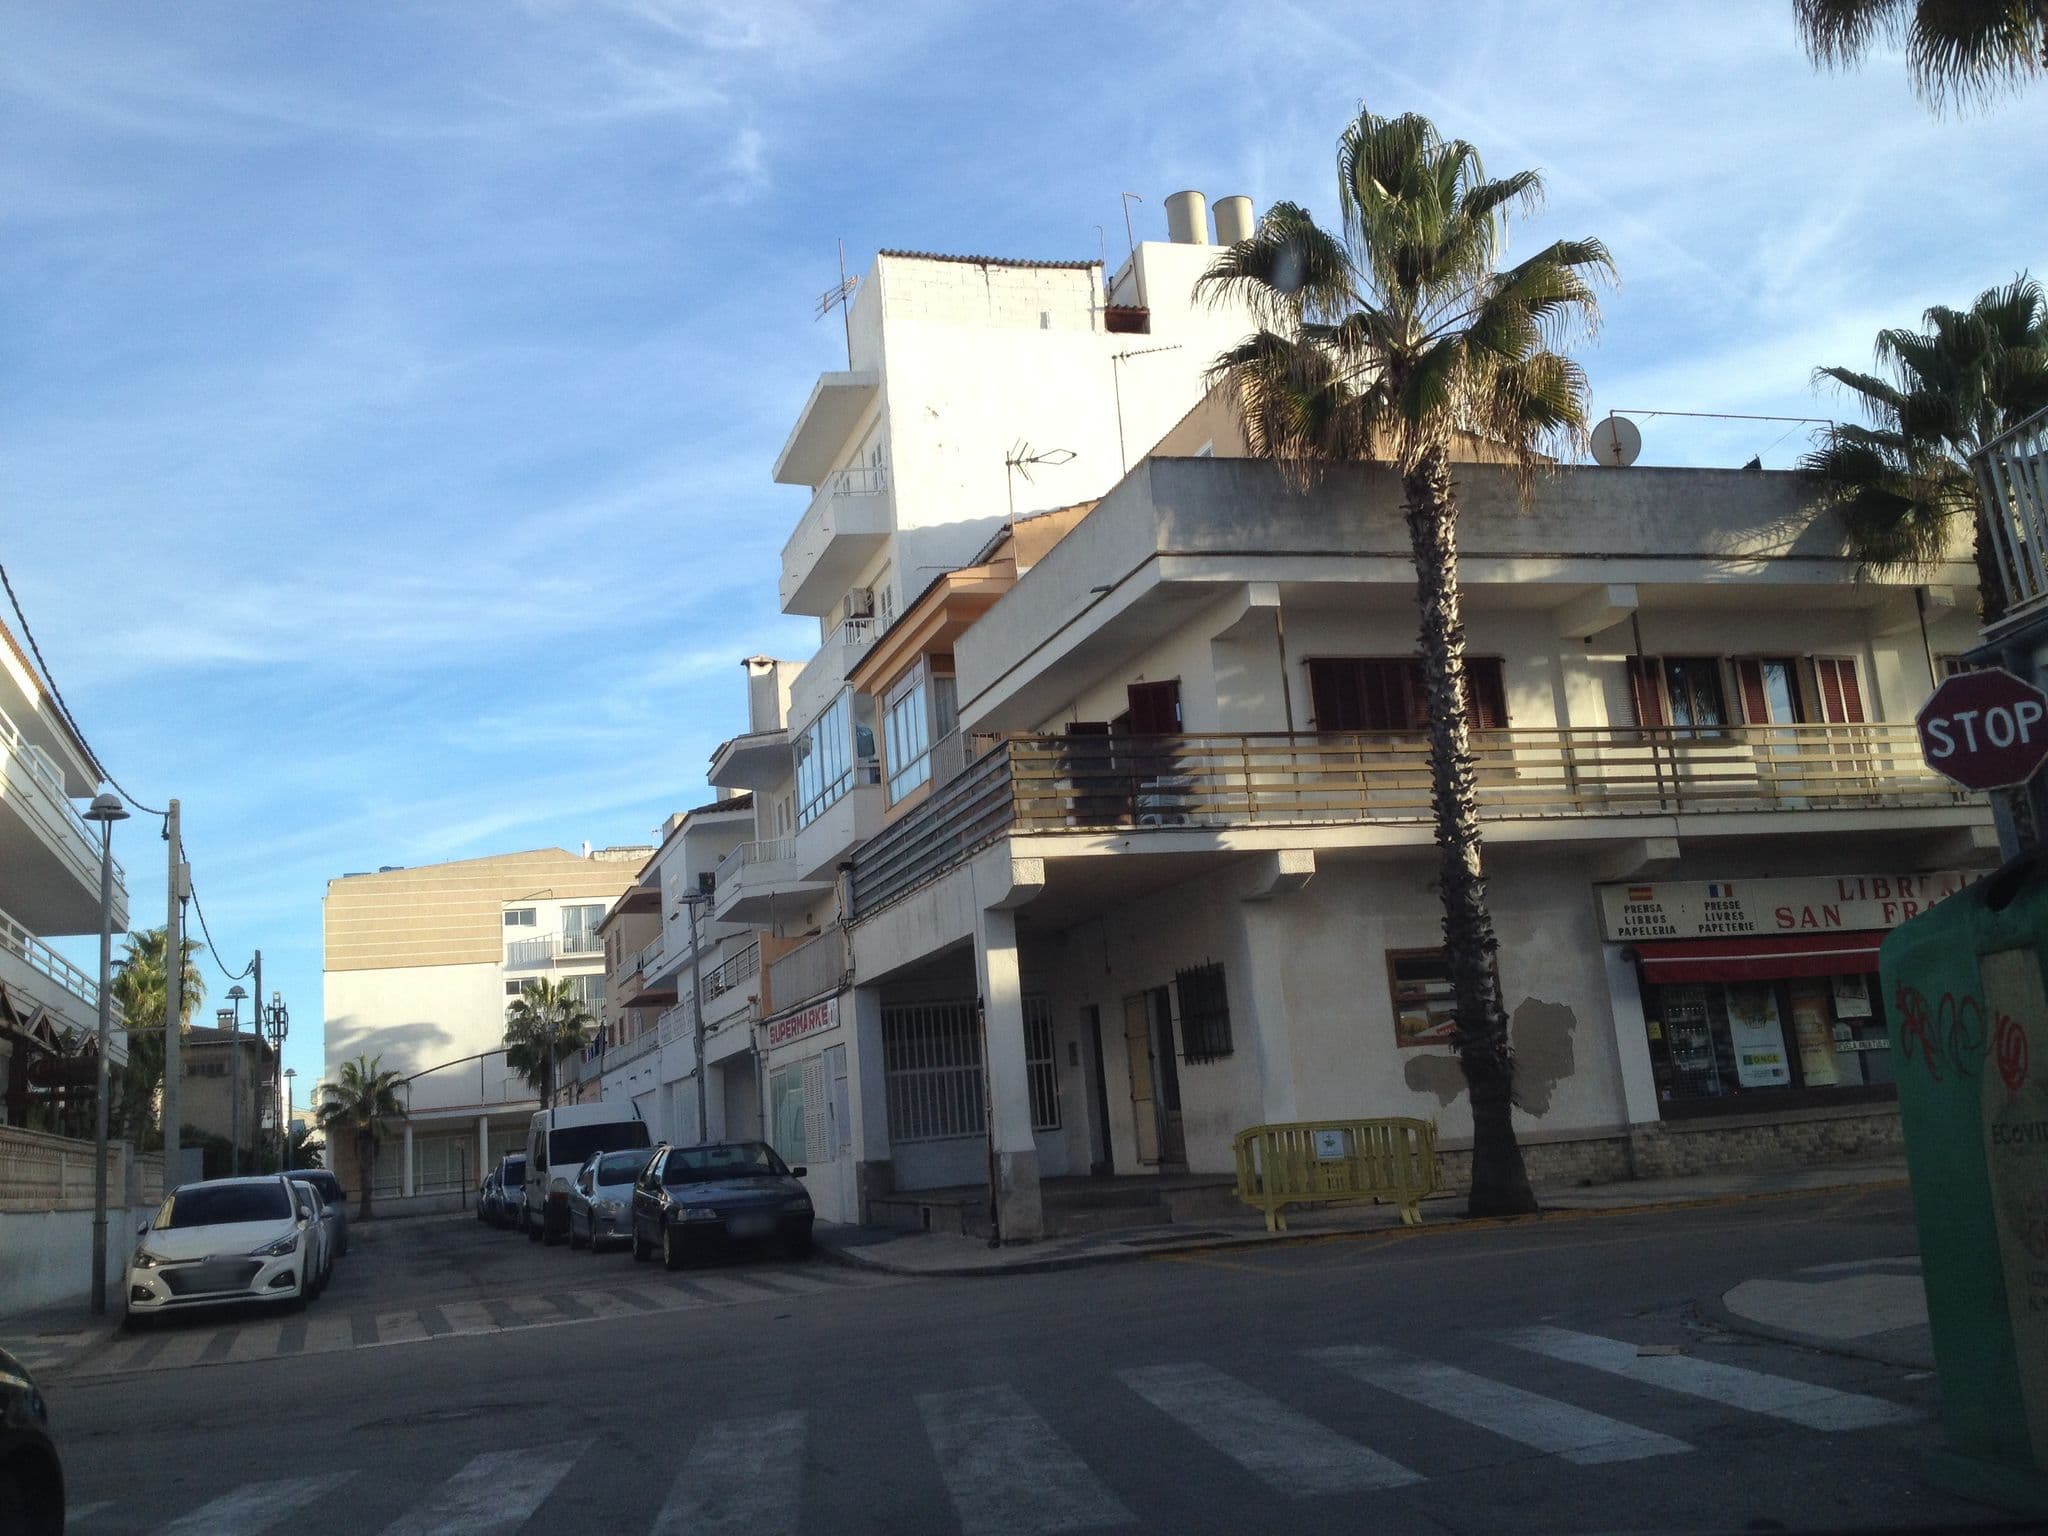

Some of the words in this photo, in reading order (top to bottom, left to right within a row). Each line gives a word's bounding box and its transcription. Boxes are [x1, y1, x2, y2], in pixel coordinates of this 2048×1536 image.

[1927, 701, 2043, 758] STOP
[1624, 903, 1663, 914] PRENSA
[1704, 900, 1741, 911] PRESSE
[1625, 914, 1667, 925] LIBROS
[1705, 911, 1744, 922] LIVRES
[1775, 904, 1841, 928] SAN
[1618, 925, 1677, 937] PAPELERIA
[1698, 922, 1755, 934] PAPETERIE
